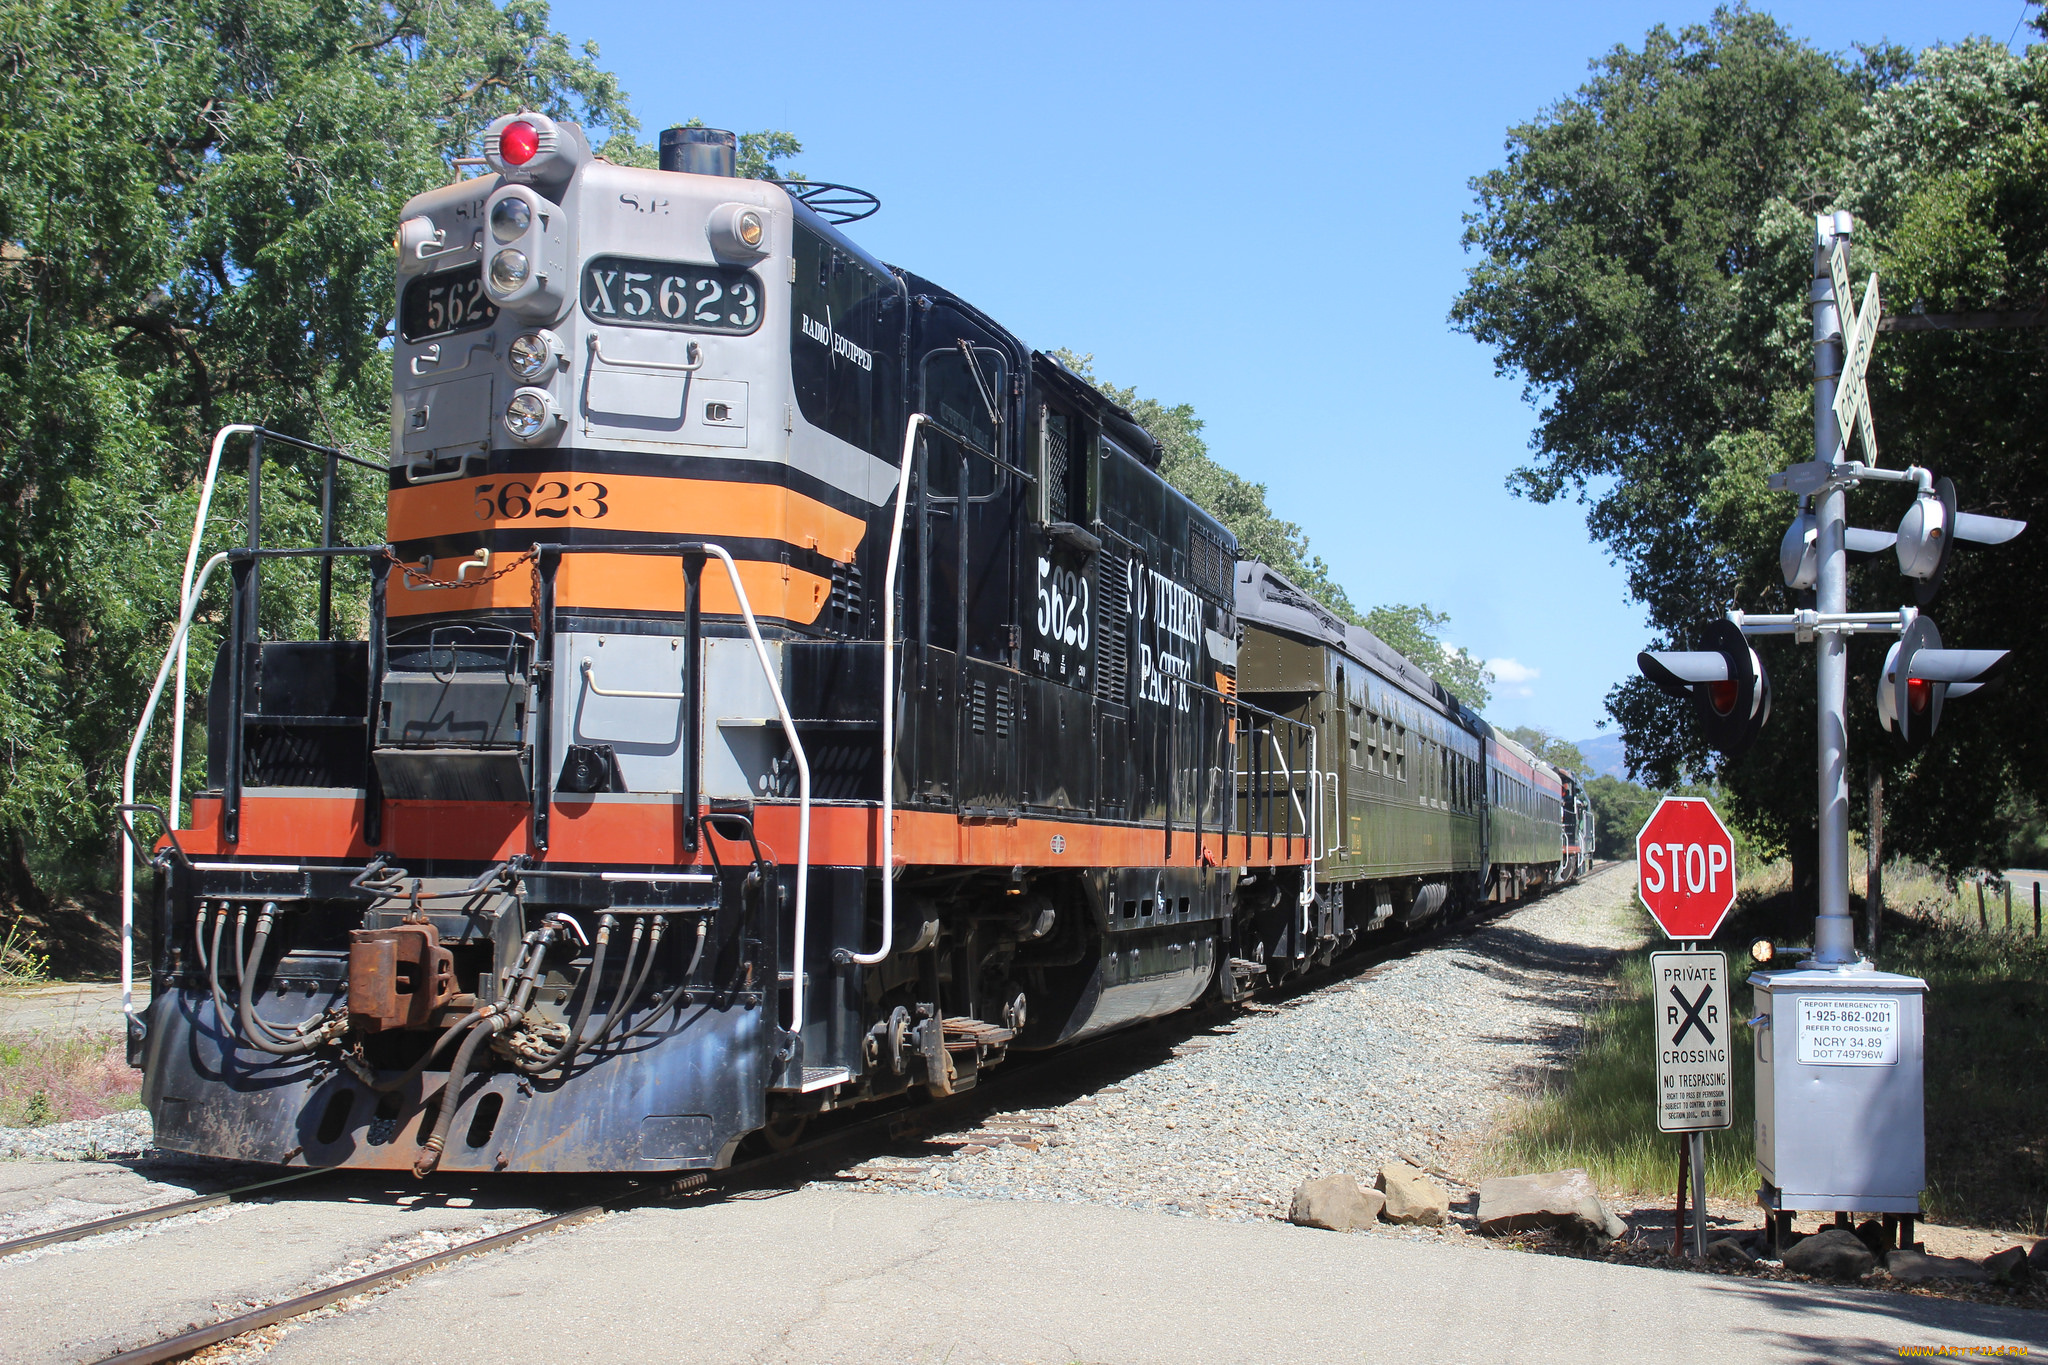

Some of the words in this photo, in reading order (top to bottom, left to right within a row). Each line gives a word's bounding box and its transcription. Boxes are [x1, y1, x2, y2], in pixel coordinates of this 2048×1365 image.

[428, 278, 494, 330] 562
[589, 269, 757, 326] X5623
[1834, 251, 1852, 341] RAIL
[802, 313, 829, 346] RADIO
[834, 332, 872, 371] EQUIPPED
[1842, 292, 1878, 427] CROSSING
[474, 481, 609, 521] 5623
[1037, 556, 1089, 651] 5623
[1645, 842, 1728, 894] STOP
[1664, 968, 1717, 982] PRIVATE
[1667, 1006, 1679, 1025] R
[1707, 1005, 1719, 1024] R
[1805, 1010, 1890, 1022] 1-925-862-0201
[1806, 1024, 1830, 1032] REFER
[1663, 1049, 1725, 1064] CROSSING
[1813, 1037, 1847, 1047] NCRY
[1849, 1037, 1882, 1048] 34.89
[1813, 1049, 1834, 1058] DOT
[1836, 1049, 1883, 1059] 749796W
[1664, 1075, 1675, 1088] NO
[1679, 1073, 1726, 1088] TRESPASSING
